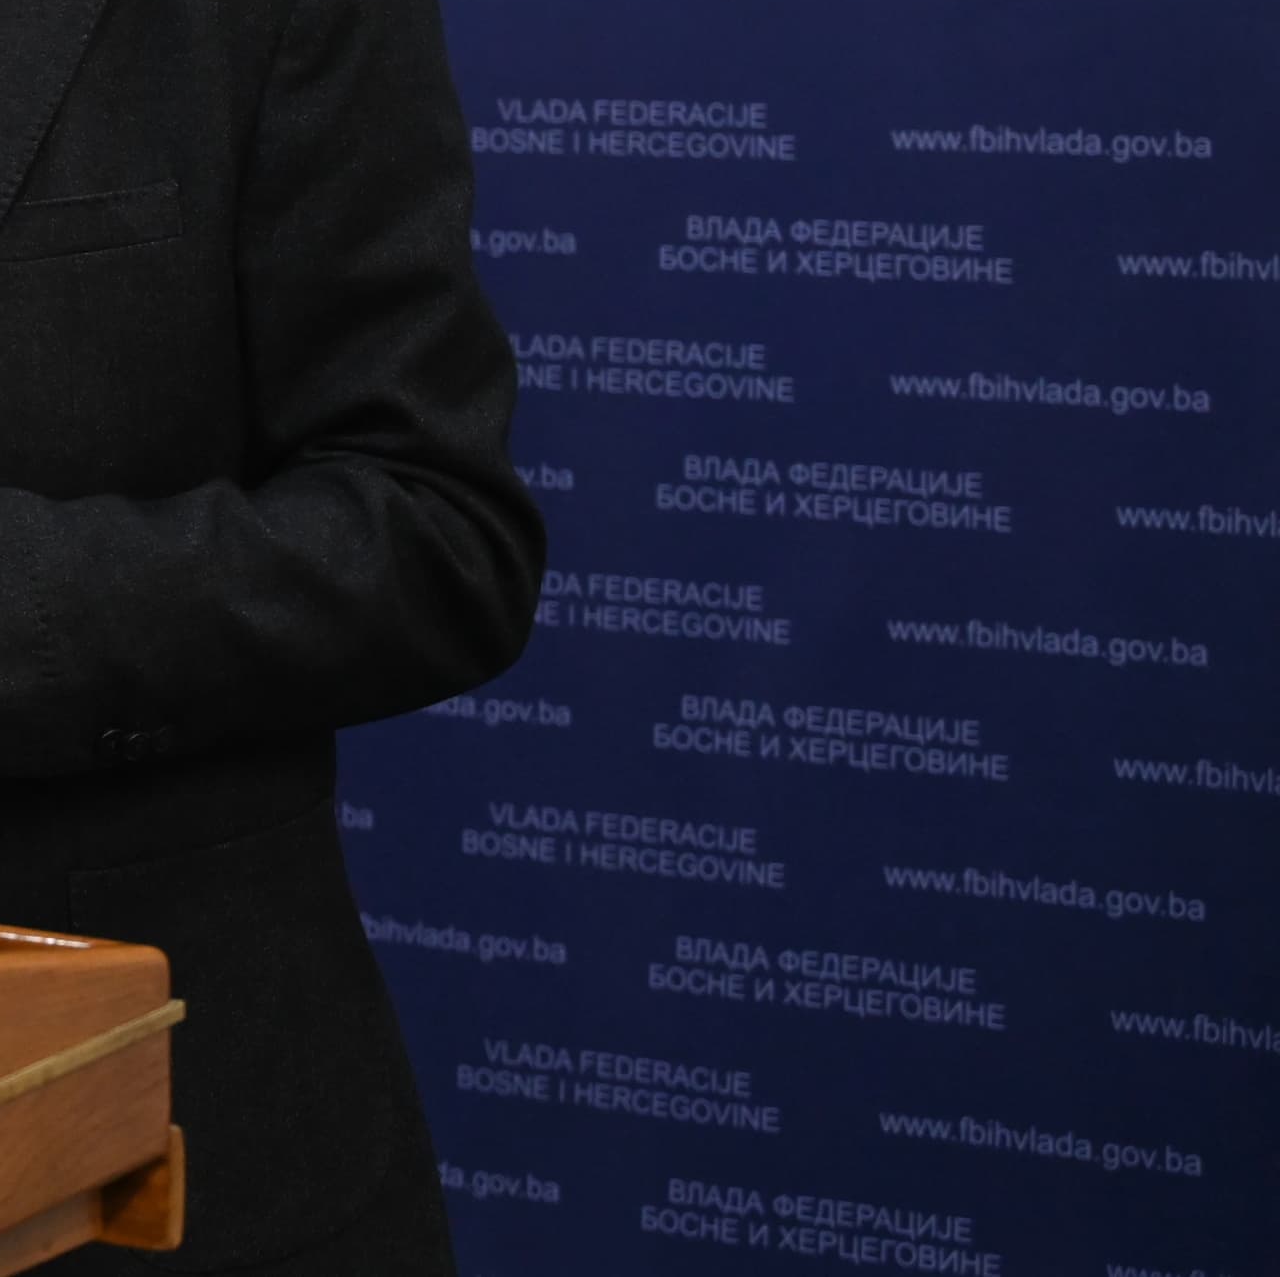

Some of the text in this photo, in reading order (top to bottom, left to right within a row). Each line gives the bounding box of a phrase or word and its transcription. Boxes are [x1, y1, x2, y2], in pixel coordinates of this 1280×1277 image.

[497, 98, 768, 129] VLADA FEDERACIJE
[471, 126, 796, 160] BOSNE I HERCEGOVINE
[890, 125, 1212, 163] www.fbihvlada.gov.ba
[687, 216, 983, 252] ВЛАДА ФЕДЕРАЦИЈЕ
[659, 245, 1013, 285] БОСНЕ И ХЕРЦЕГОВИНЕ
[591, 337, 765, 370] FEDERACIJE
[571, 367, 578, 390] I
[587, 367, 794, 403] HERCEGOVINE
[890, 372, 1210, 415] www.fbihvlada.gov.ba
[684, 455, 982, 498] ВЛАДА ФЕДЕРАЦИЈЕ
[656, 483, 1011, 533] БОСНЕ И ХЕРЦЕГОВИНЕ
[588, 574, 764, 612] FEDERACIJE
[583, 604, 791, 645] HERCEGOVINE
[886, 618, 1209, 667] www.fbihvlada.gov.ba
[681, 695, 980, 747] ВЛАДА ФЕДЕРАЦИЈЕ
[653, 723, 1009, 781] БОСНЕ И ХЕРЦЕГОВИНЕ
[489, 801, 757, 855] VLADA FEDERACIJE
[462, 829, 556, 864] BOSNE
[580, 843, 784, 890] HERCEGOVINE
[883, 864, 1206, 921] www.fbihvlada.gov.ba
[675, 935, 976, 995] ВЛАДА ФЕДЕРАЦИЈЕ
[648, 963, 1006, 1031] БОСНЕ И ХЕРЦЕГОВИНЕ
[483, 1037, 752, 1098] VLADA FEDERACIJE
[456, 1064, 551, 1102] BOSNE
[573, 1081, 782, 1133] HERCEGOVINE
[879, 1112, 1202, 1176] www.fbihvlada.gov.ba
[669, 1177, 972, 1243] ВЛАДА ФЕДЕРАЦИЈЕ
[641, 1206, 1001, 1277] БОСНЕ И ХЕРЦЕГОВИНЕ
